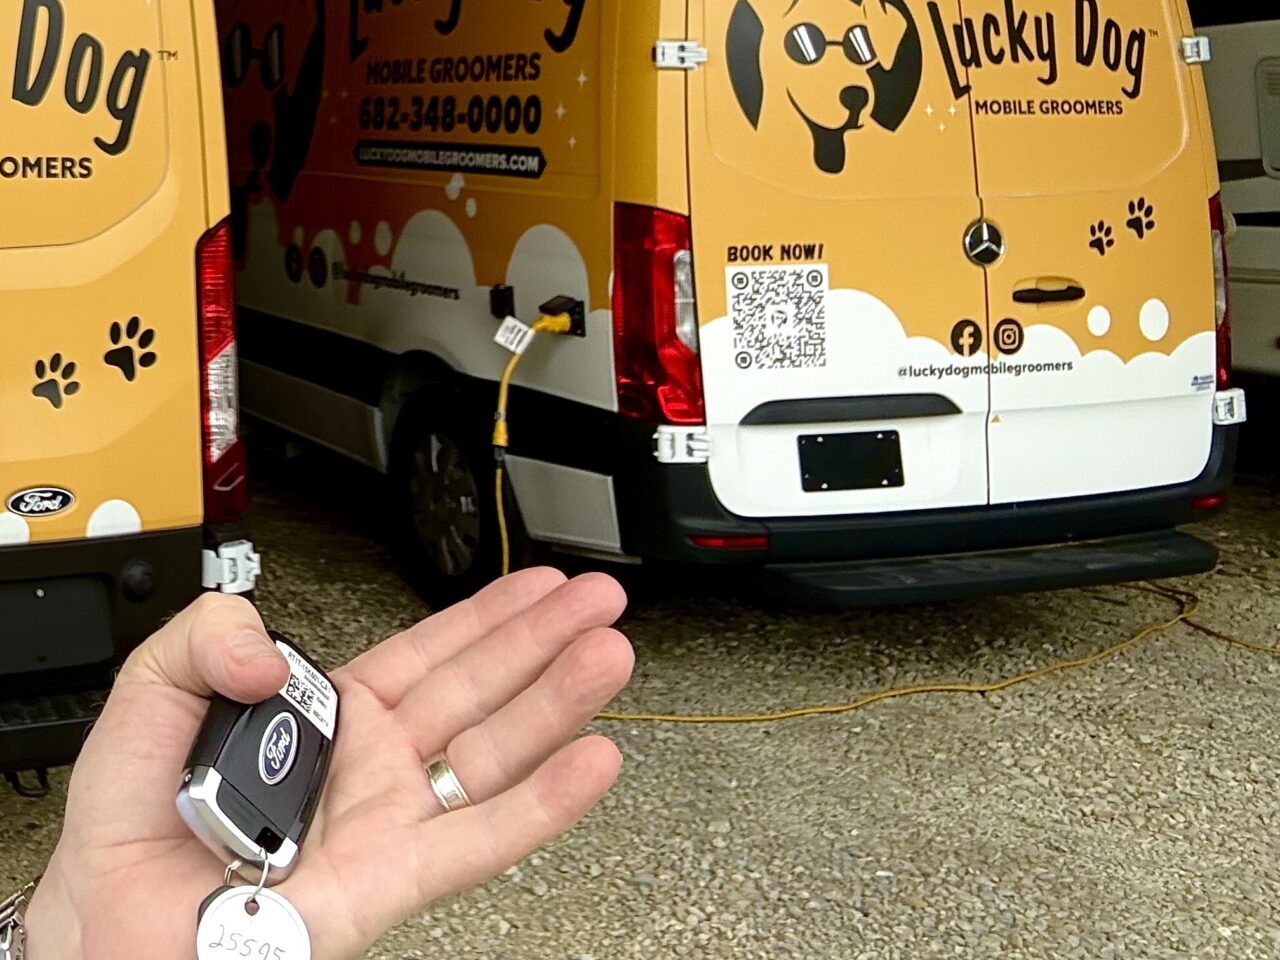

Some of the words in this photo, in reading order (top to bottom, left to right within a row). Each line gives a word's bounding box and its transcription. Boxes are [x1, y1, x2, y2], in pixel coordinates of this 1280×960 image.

[366, 57, 427, 85] MOBILE
[429, 52, 542, 83] GROOMERS
[359, 94, 542, 135] 682-348-0000
[974, 100, 1036, 116] MOBILE
[1038, 100, 1124, 116] GROOMERS
[727, 244, 774, 263] BOOK
[780, 242, 824, 262] NOW!
[898, 360, 1074, 380] @luckydogmobilegroomers
[19, 492, 63, 512] Ford
[266, 727, 291, 770] Ford
